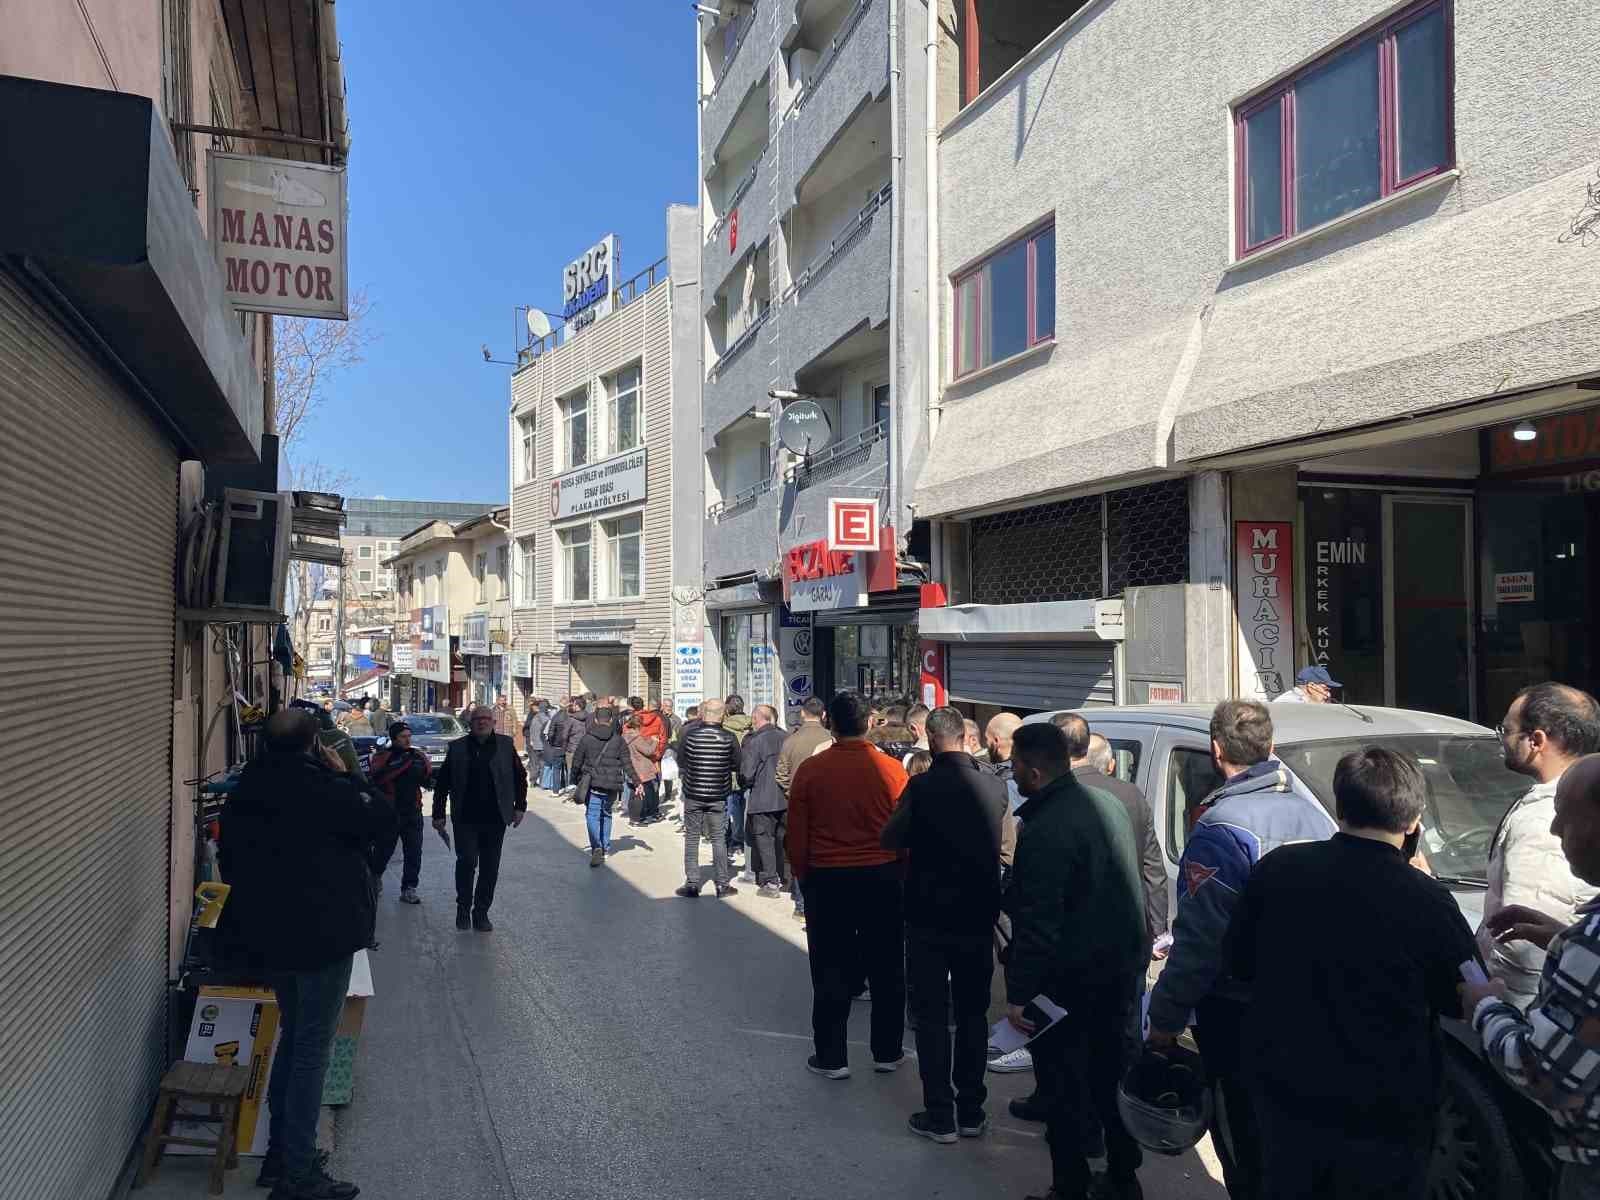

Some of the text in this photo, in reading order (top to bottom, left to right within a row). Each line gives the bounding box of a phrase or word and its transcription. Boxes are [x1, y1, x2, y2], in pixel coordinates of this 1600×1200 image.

[221, 208, 335, 254] MANAS
[225, 257, 334, 301] MOTOR
[565, 242, 608, 301] SRC
[571, 500, 592, 513] PLAKA
[1316, 536, 1365, 564] EMİN
[1252, 528, 1282, 693] MUHACIR
[676, 657, 702, 665] LADA
